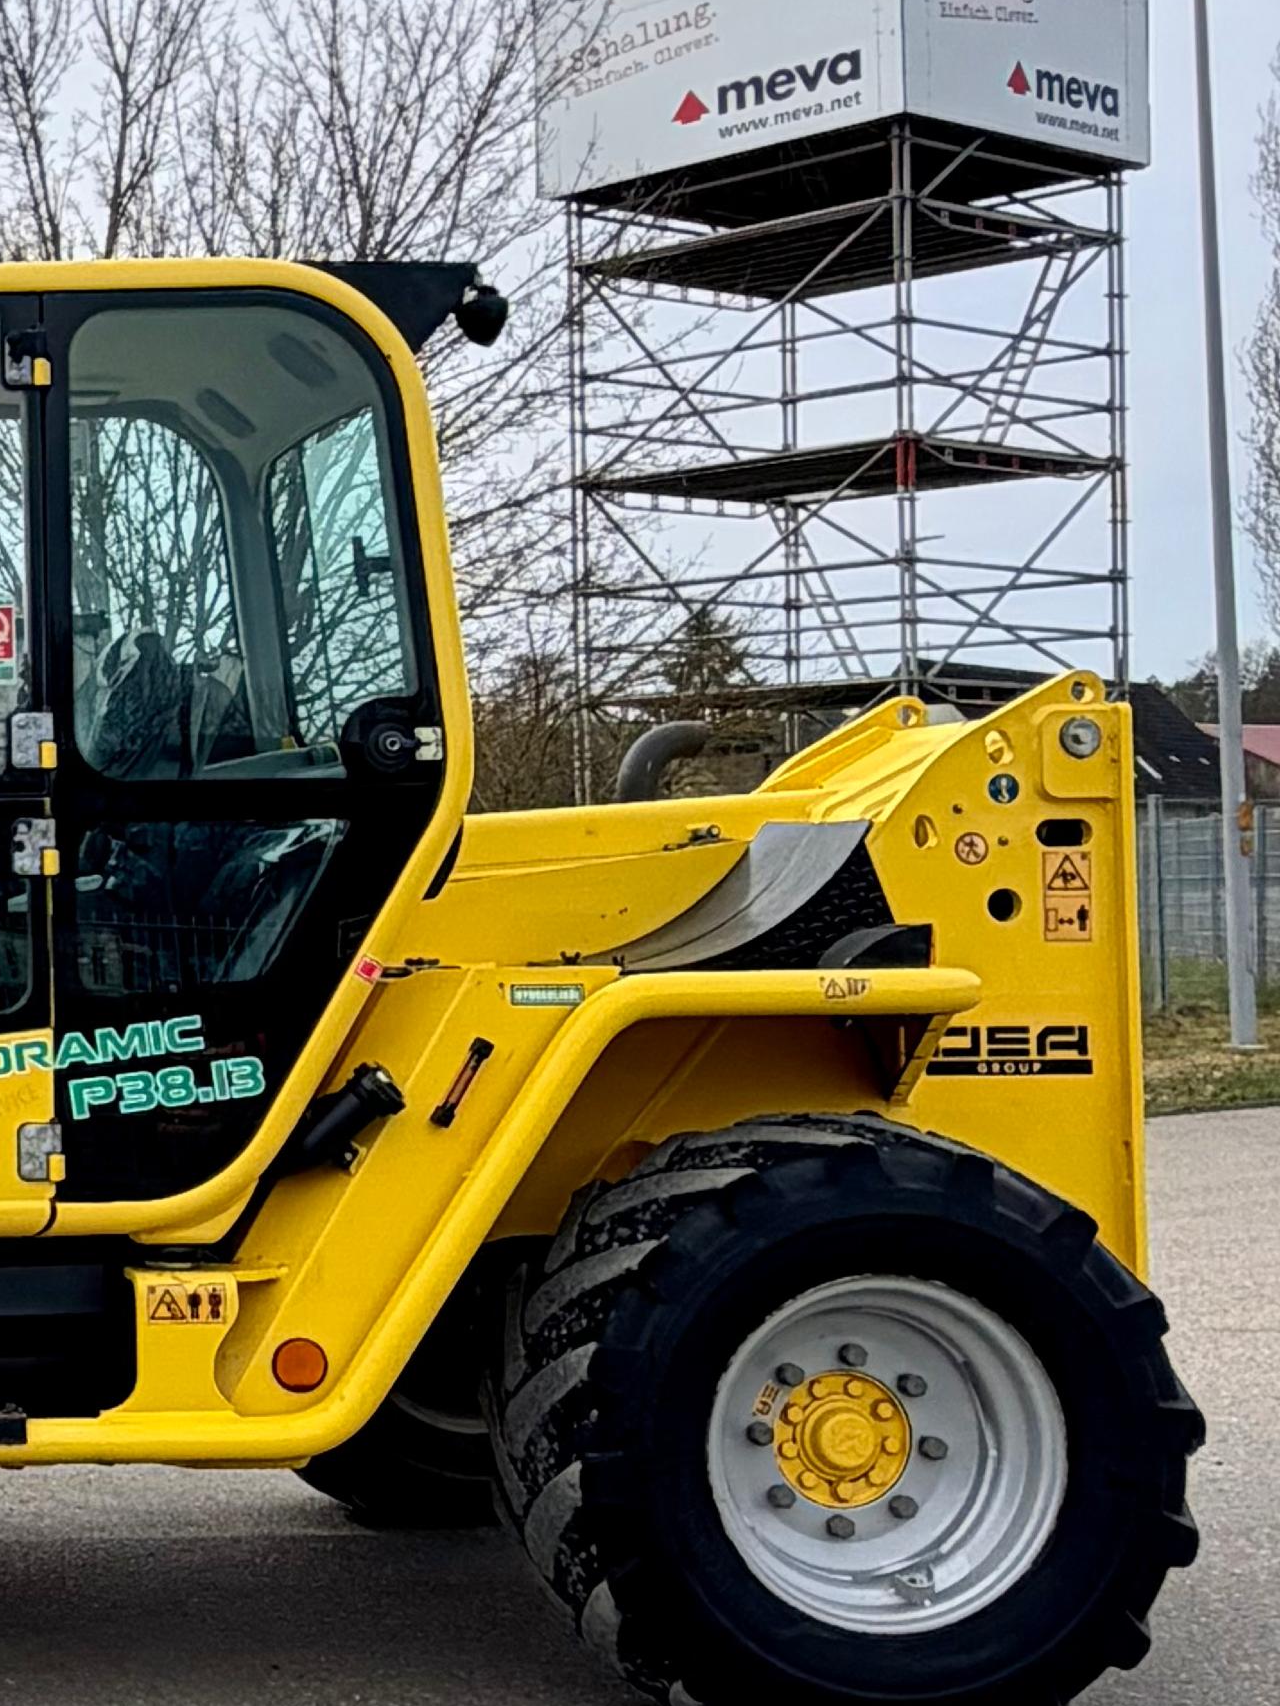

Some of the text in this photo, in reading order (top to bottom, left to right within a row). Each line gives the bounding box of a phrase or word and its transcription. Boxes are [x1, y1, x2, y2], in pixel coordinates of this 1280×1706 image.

[654, 32, 720, 65] Clever.
[717, 49, 861, 115] meva
[1035, 69, 1120, 117] meva
[718, 91, 862, 139] www.meva.net
[1036, 111, 1120, 141] www.meva.net
[68, 1056, 266, 1121] P38.13
[976, 1061, 1042, 1073] GROUP
